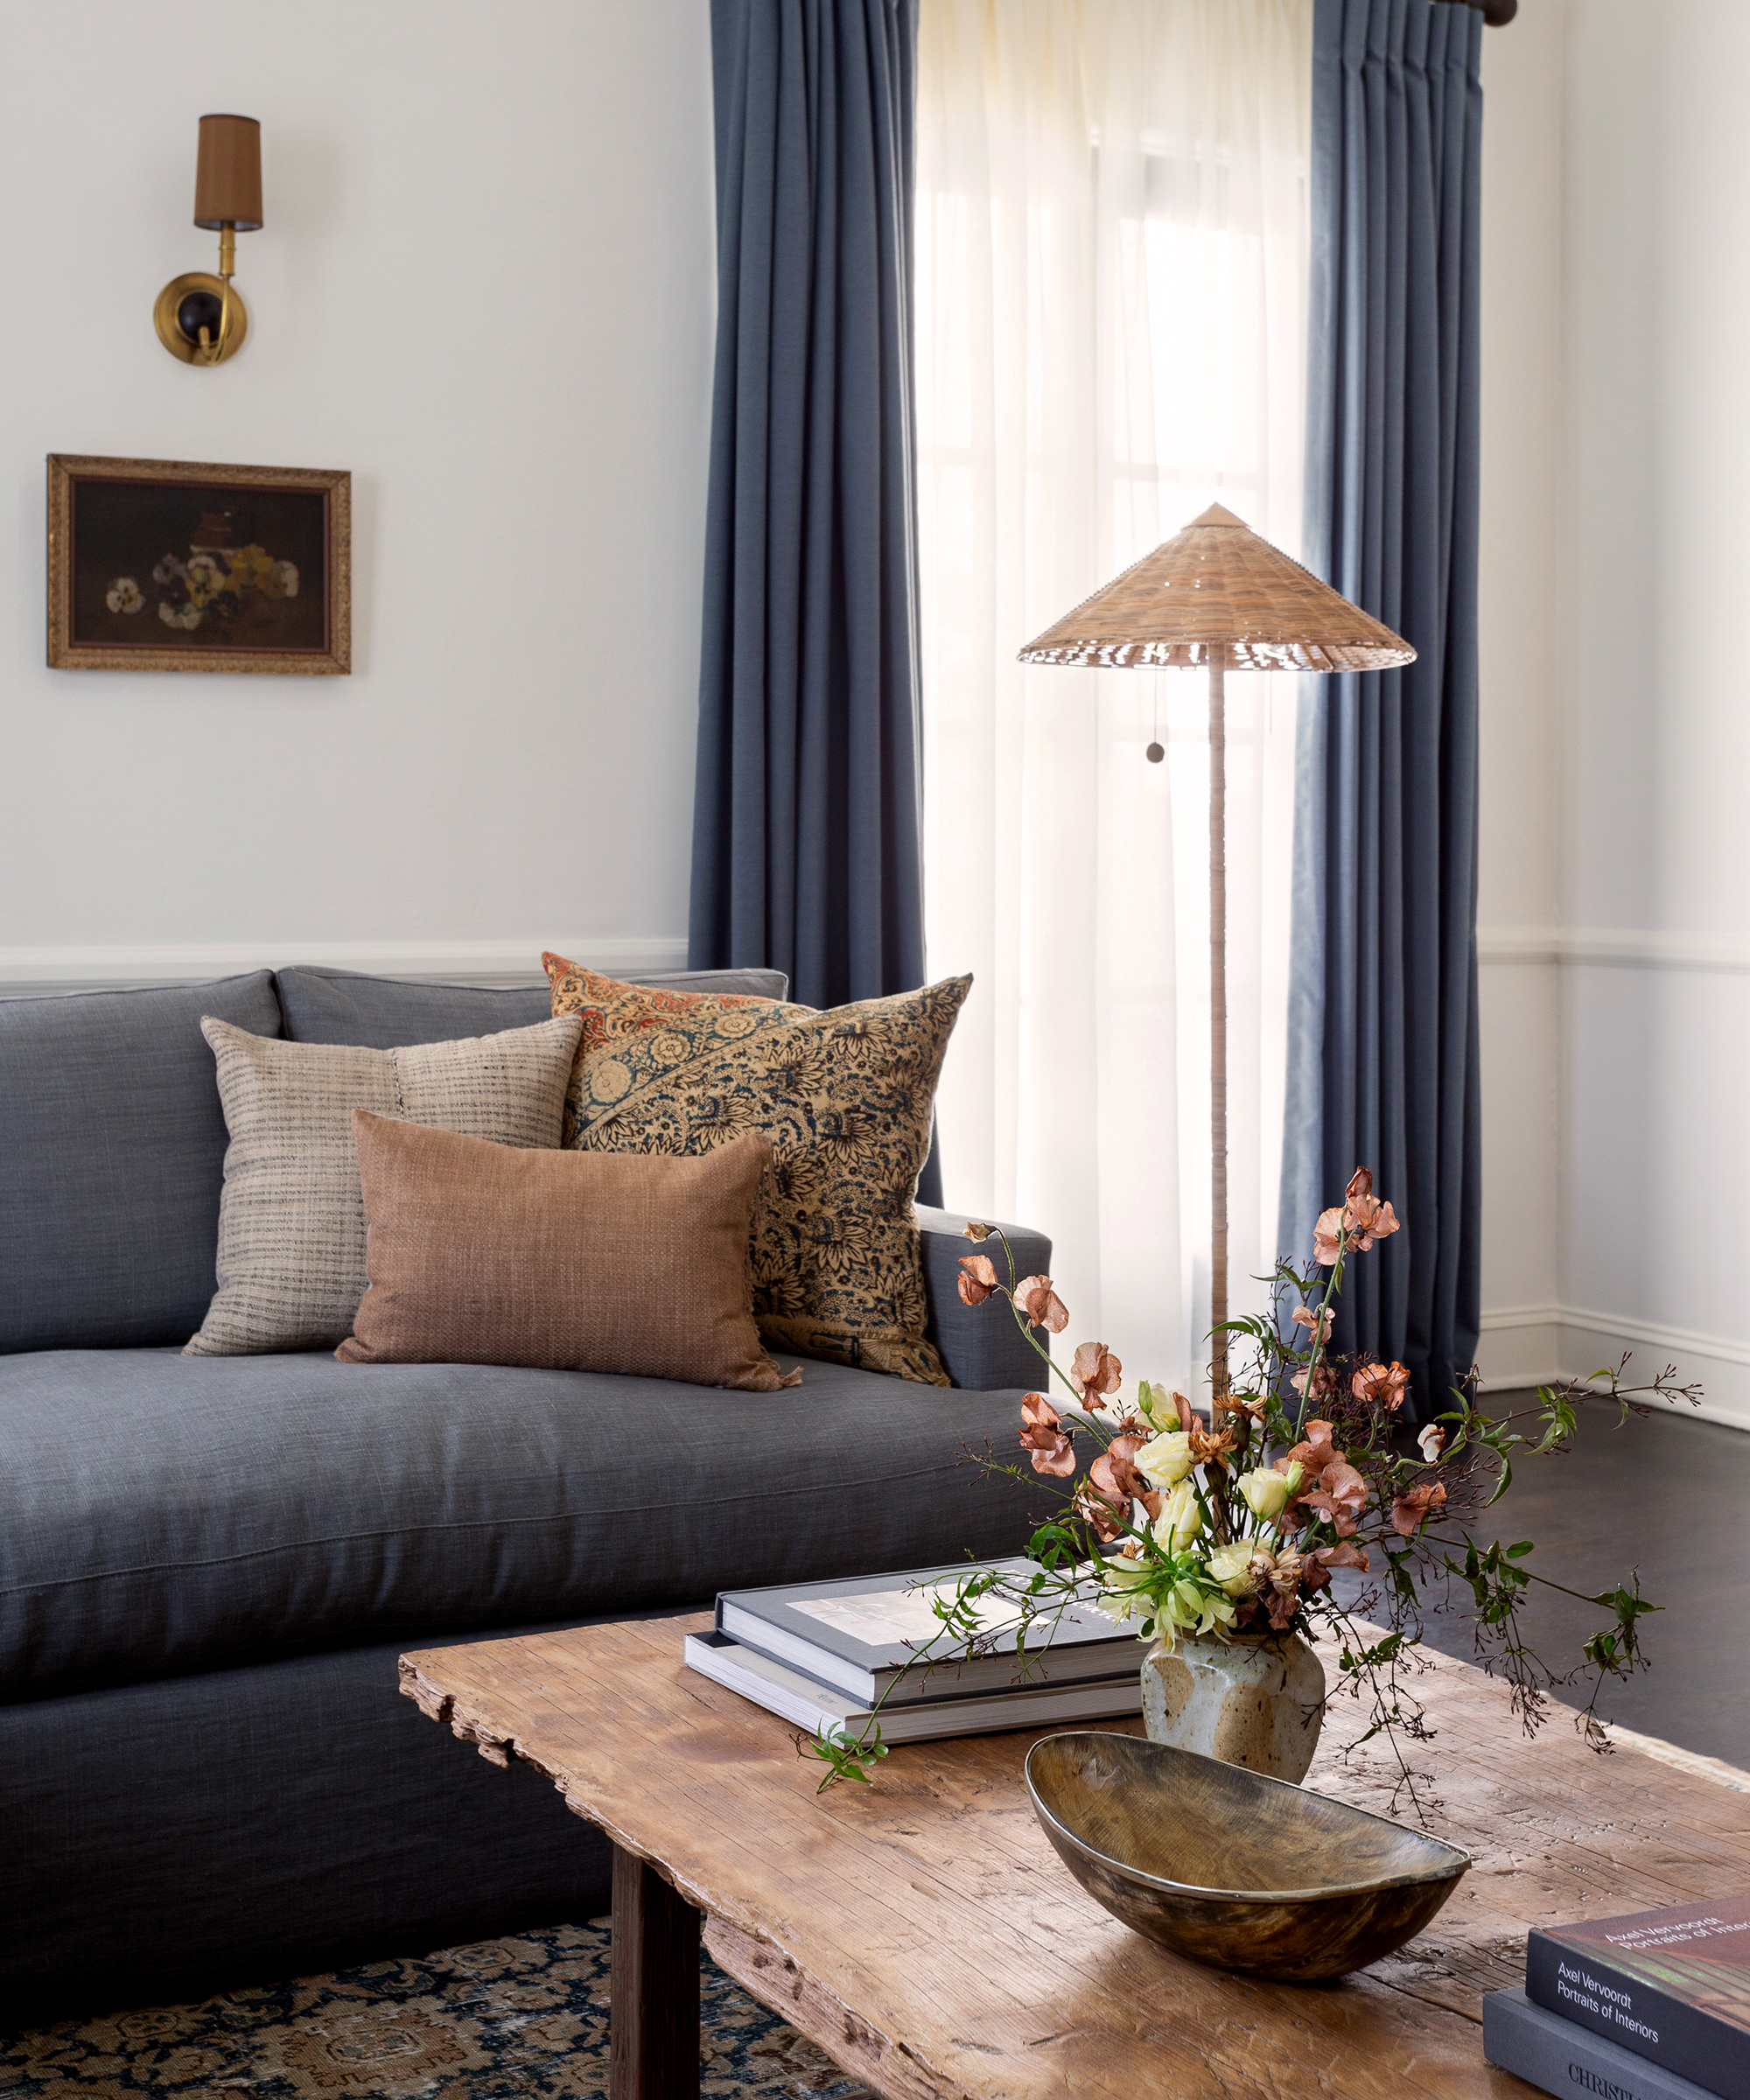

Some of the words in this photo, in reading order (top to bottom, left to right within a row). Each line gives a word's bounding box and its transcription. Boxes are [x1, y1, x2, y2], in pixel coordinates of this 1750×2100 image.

[1605, 1930, 1645, 1942] Axel
[1640, 1917, 1724, 1936] Vervoordt
[1619, 1934, 1691, 1950] Portraits
[1693, 1928, 1712, 1938] of
[1710, 1921, 1750, 1934] Inter
[1558, 1961, 1580, 1984] Axel
[1581, 1971, 1632, 2010] Vervoordt
[1558, 1980, 1600, 2013] Portraits
[1601, 2005, 1613, 2020] of
[1615, 2008, 1659, 2043] Interiors
